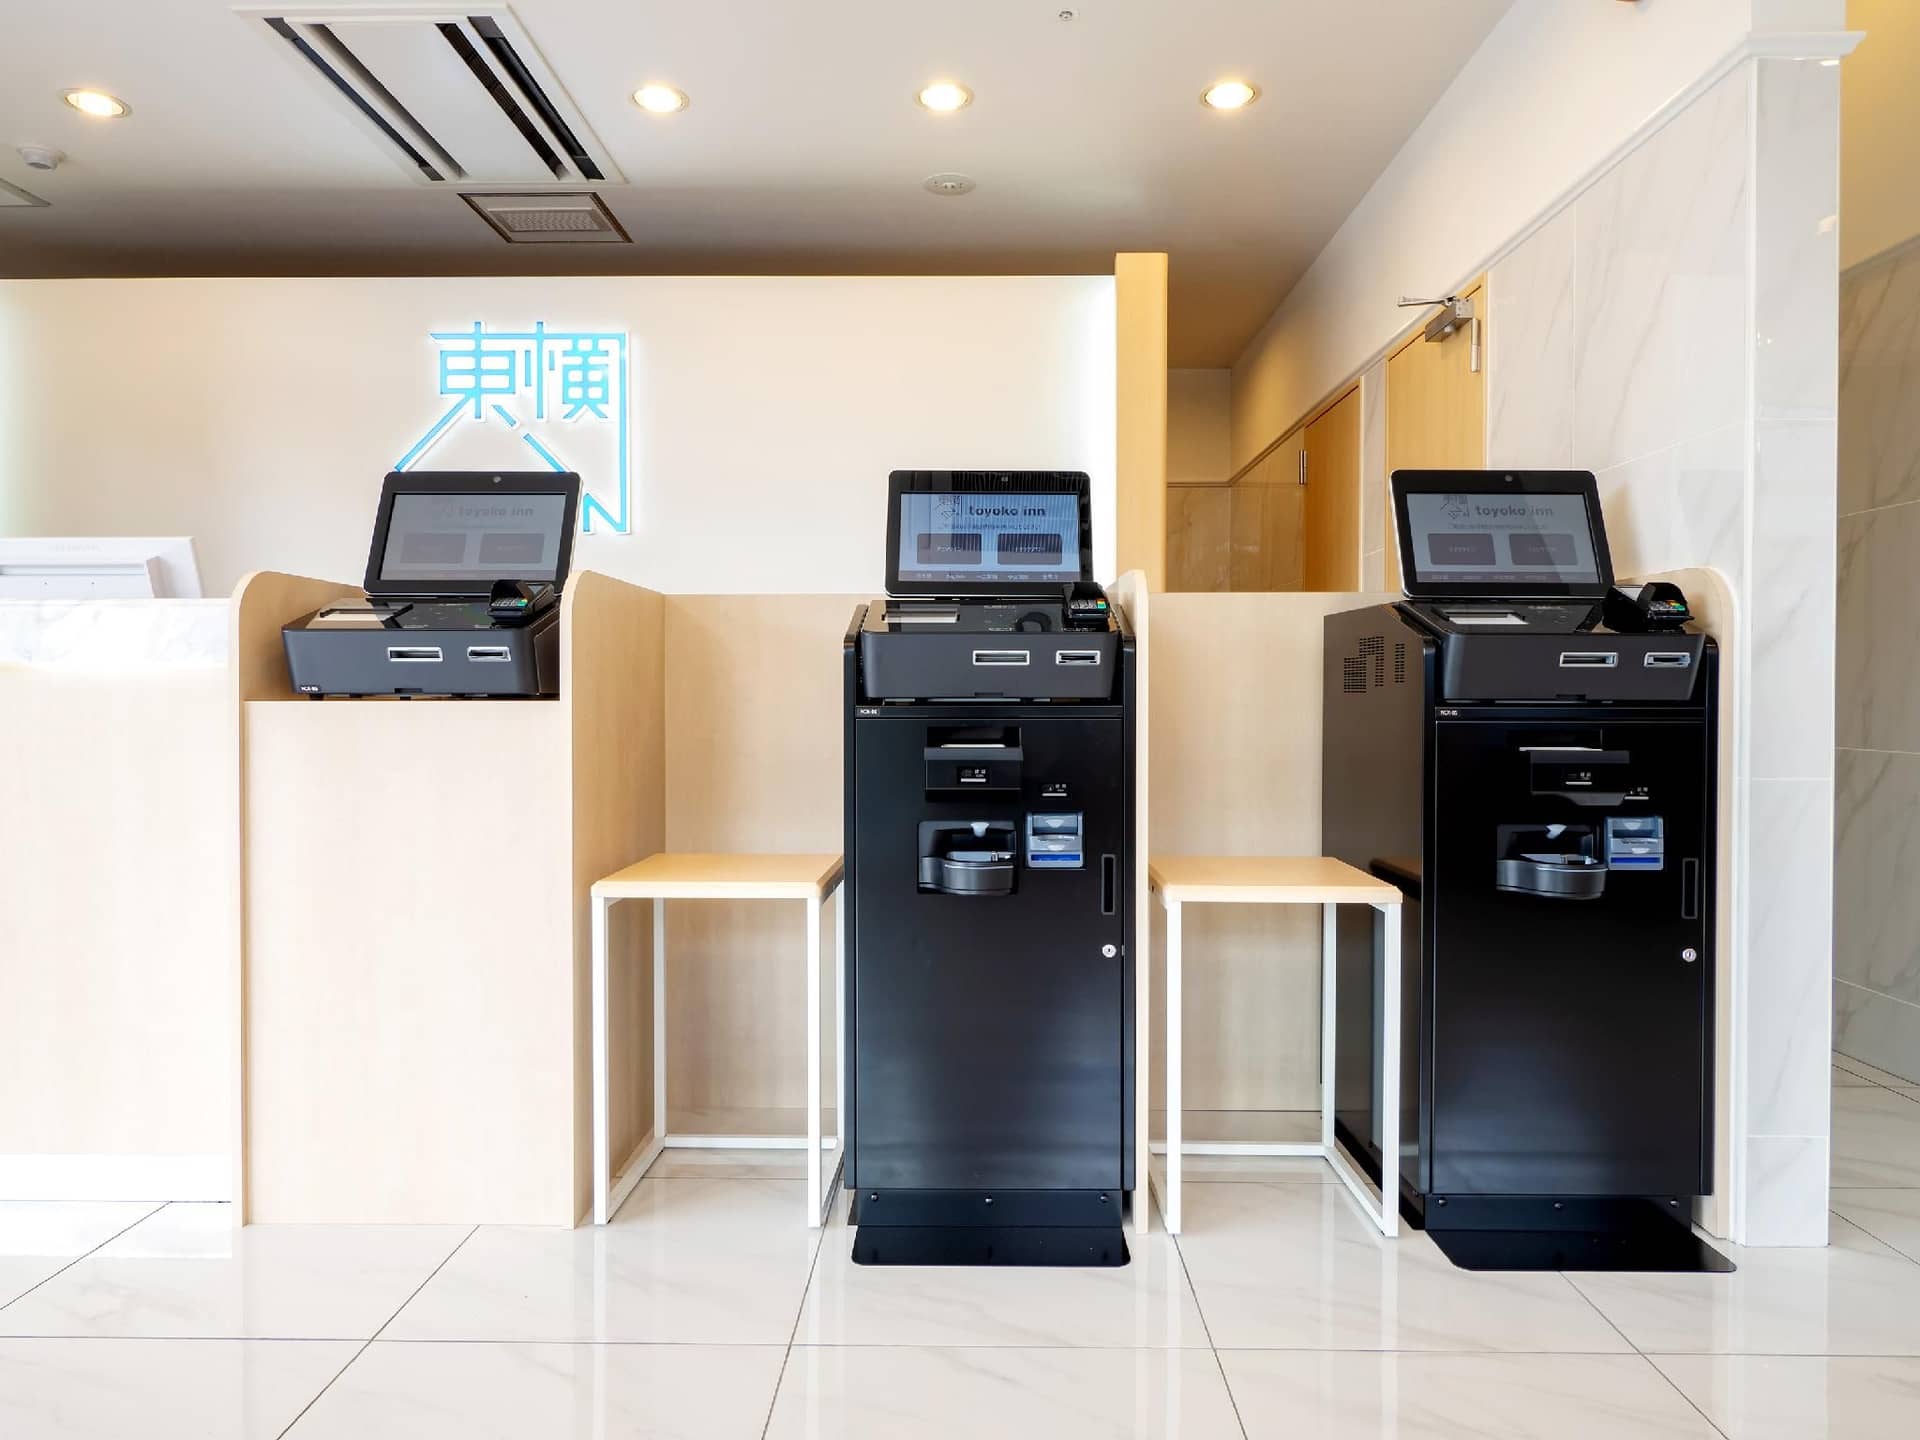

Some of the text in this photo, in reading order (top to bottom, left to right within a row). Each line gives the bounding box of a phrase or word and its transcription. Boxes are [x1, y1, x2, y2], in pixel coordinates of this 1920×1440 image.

[511, 504, 534, 516] inn
[969, 505, 1019, 521] toyoko
[1024, 505, 1047, 517] inn
[1475, 504, 1526, 521] toyoko
[1530, 505, 1554, 517] inn
